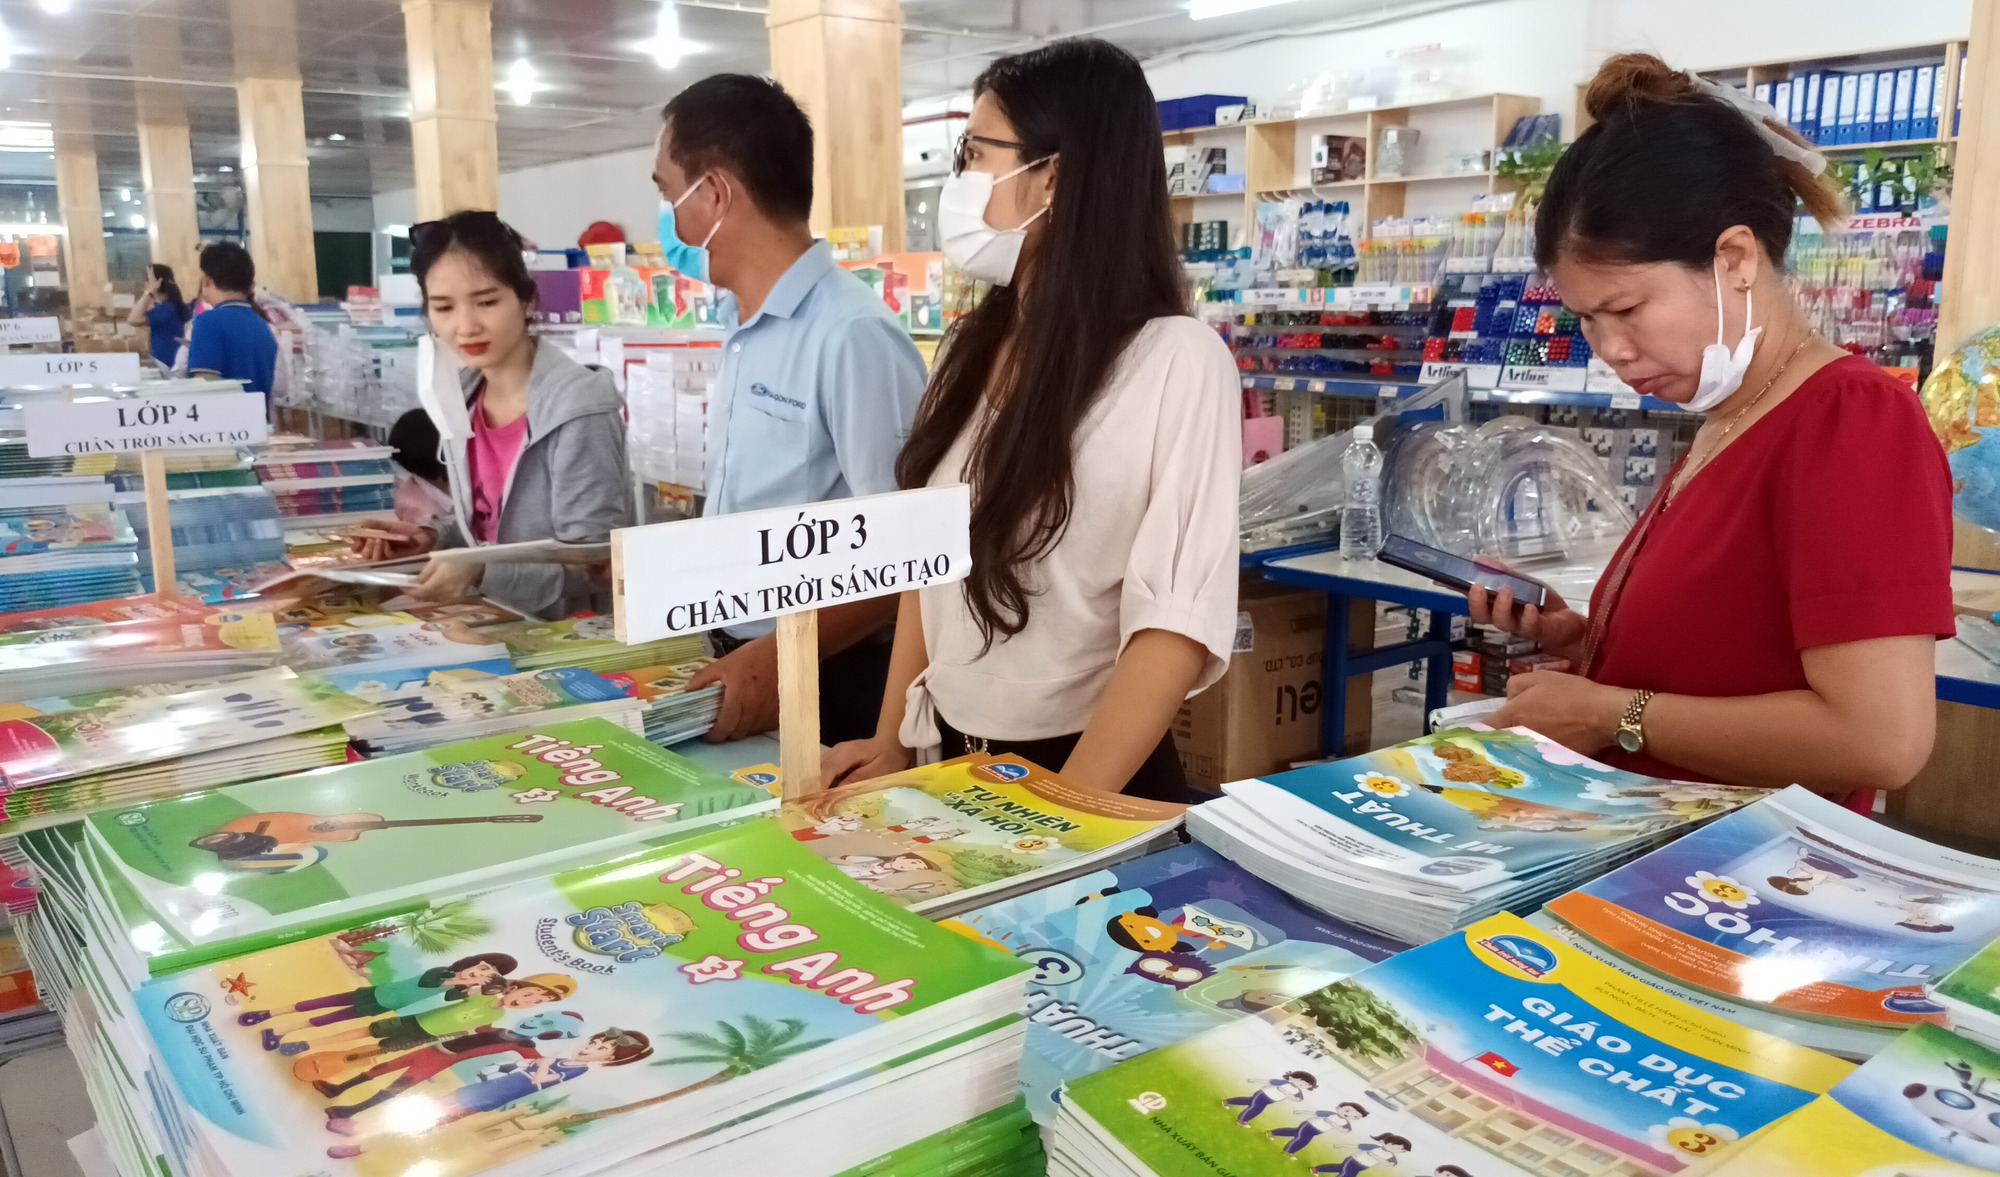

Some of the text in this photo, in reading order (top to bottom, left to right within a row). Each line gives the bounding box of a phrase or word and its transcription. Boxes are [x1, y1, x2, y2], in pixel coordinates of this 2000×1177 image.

[1848, 217, 1921, 229] ZEBRA
[46, 354, 98, 374] LỚP 5
[117, 401, 200, 428] LỚP 4
[64, 430, 250, 454] CHÂN TRỜI SÁNG TẠO
[757, 512, 868, 566] LỚP 3
[666, 553, 950, 632] CHÂN TRỜI SÁNG TẠO
[1263, 658, 1284, 673] LTD.
[1276, 680, 1322, 726] eli
[405, 774, 450, 799] Workbook
[506, 733, 622, 787] Tiếng
[581, 783, 686, 823] Anh
[1376, 780, 1396, 791] 3
[523, 791, 548, 799] 3
[963, 785, 1007, 802] TỰ
[995, 801, 1080, 832] NHIÊN
[944, 799, 1034, 835] XÃ HỘI
[1331, 789, 1455, 845] THUẬT
[1019, 840, 1043, 849] 3
[1447, 839, 1515, 856] MĨ
[1712, 884, 1738, 899] 3
[565, 906, 662, 963] Start
[612, 901, 685, 947] Smart
[657, 851, 820, 954] Tiếng
[760, 950, 920, 1015] Anh
[1664, 890, 1803, 956] HỌC
[538, 917, 616, 976] Student's Book
[697, 957, 730, 976] 3
[1034, 957, 1070, 980] 3
[1572, 942, 1737, 1015] NHÀ XUẤT BẢN GIÁO DỤC VIỆT NAM
[208, 1032, 223, 1048] XUẤT
[1520, 995, 1747, 1100] GIÁO DỤC
[203, 1054, 219, 1072] PHẠM
[214, 1070, 224, 1081] TP
[1482, 1003, 1720, 1117] THỂ CHẤT
[1149, 1116, 1174, 1133] NHÀ
[1170, 1131, 1199, 1153] XUẤT
[1195, 1150, 1218, 1168] BẢN
[1679, 1131, 1718, 1154] 3
